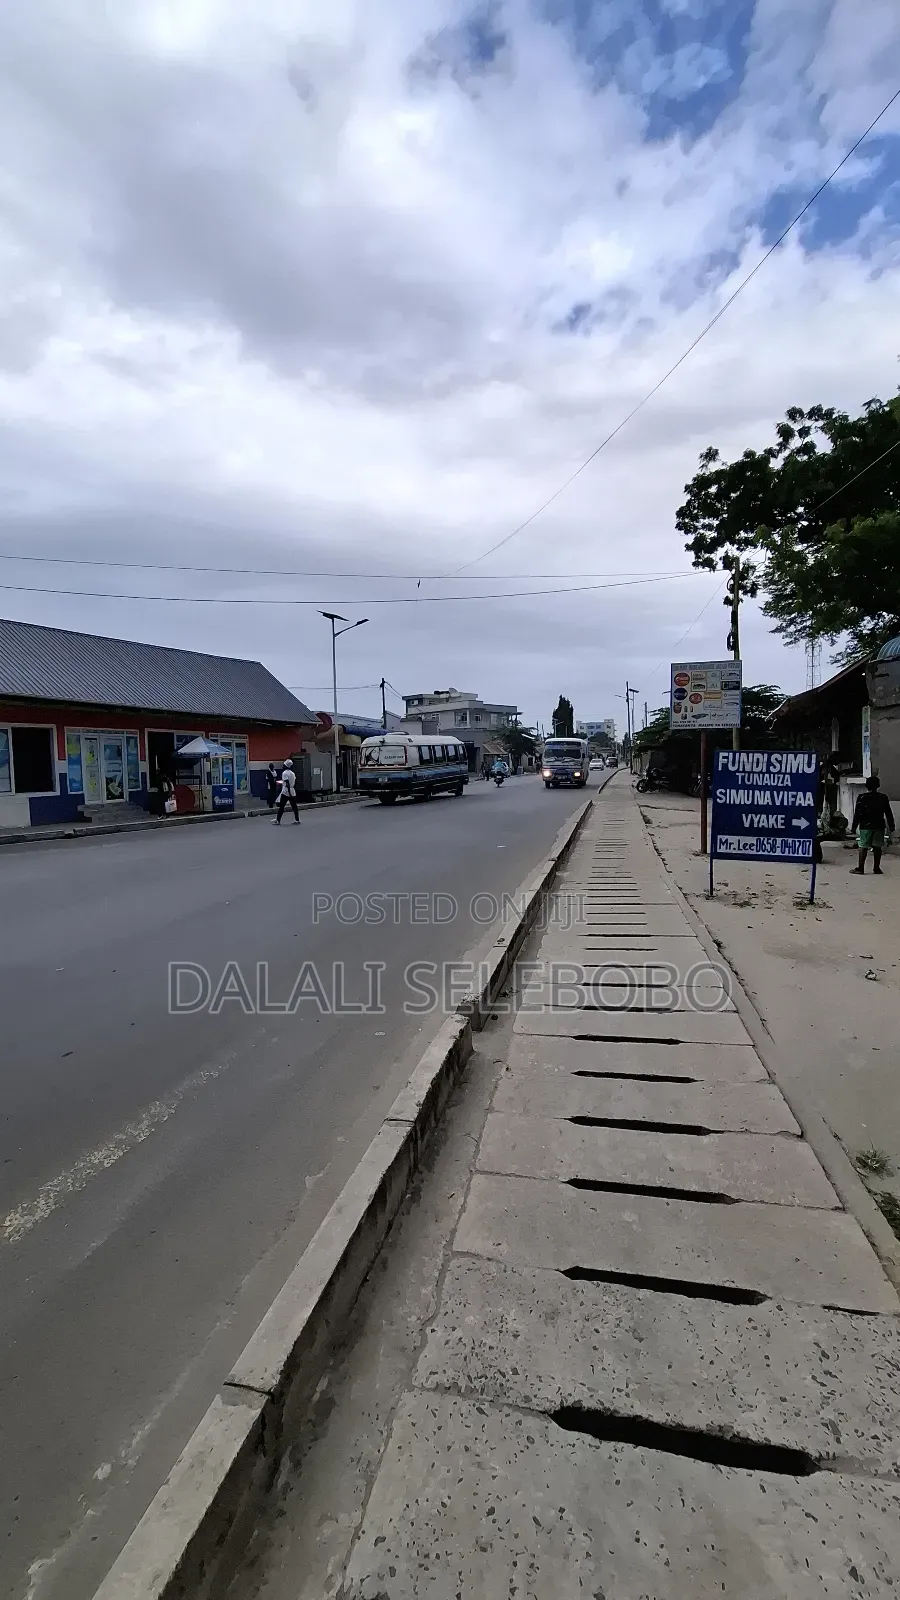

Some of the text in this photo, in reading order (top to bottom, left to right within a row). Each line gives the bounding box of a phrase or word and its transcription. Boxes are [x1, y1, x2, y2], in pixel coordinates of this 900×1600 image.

[718, 752, 817, 774] FUNDI SIMU
[736, 773, 792, 787] TUNAUZA
[716, 788, 815, 807] SIMU NA VIFAA
[742, 814, 786, 829] VYAKE
